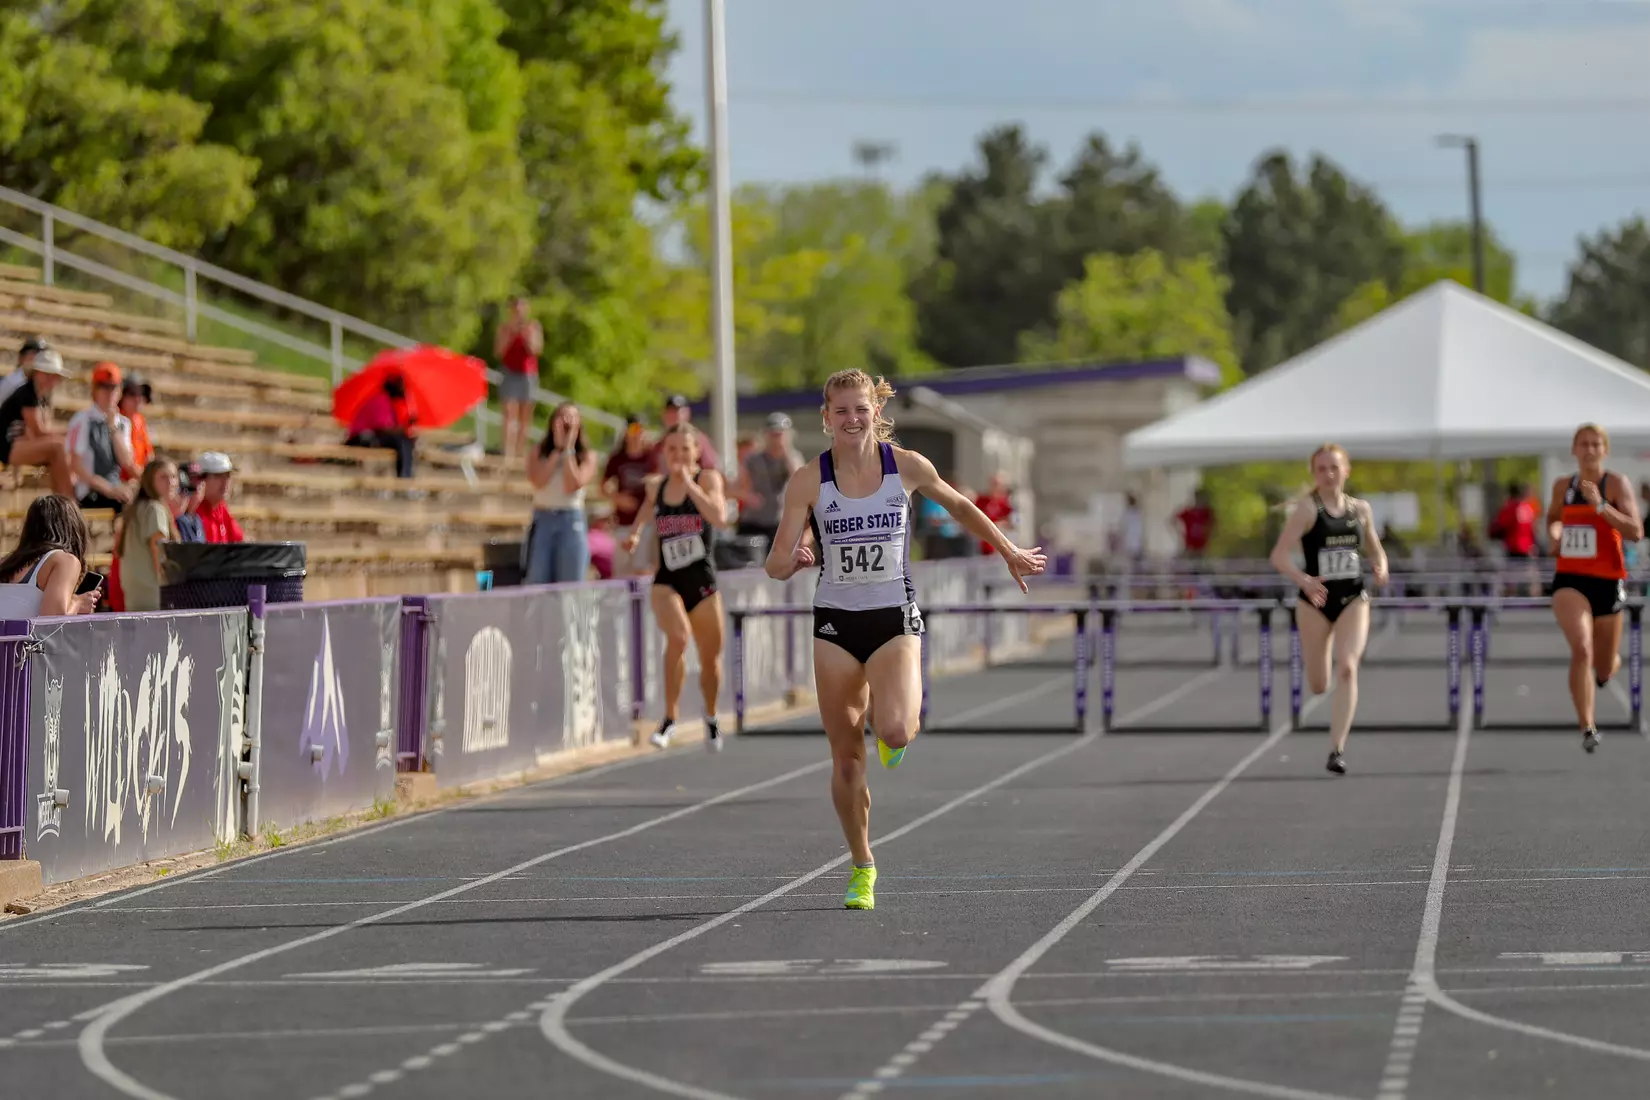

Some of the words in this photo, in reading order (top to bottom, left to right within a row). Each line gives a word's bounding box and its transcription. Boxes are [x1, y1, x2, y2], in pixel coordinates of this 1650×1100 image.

[824, 517, 864, 535] WEBER
[867, 512, 902, 530] STATE
[840, 544, 885, 574] 542
[818, 628, 838, 636] adidas
